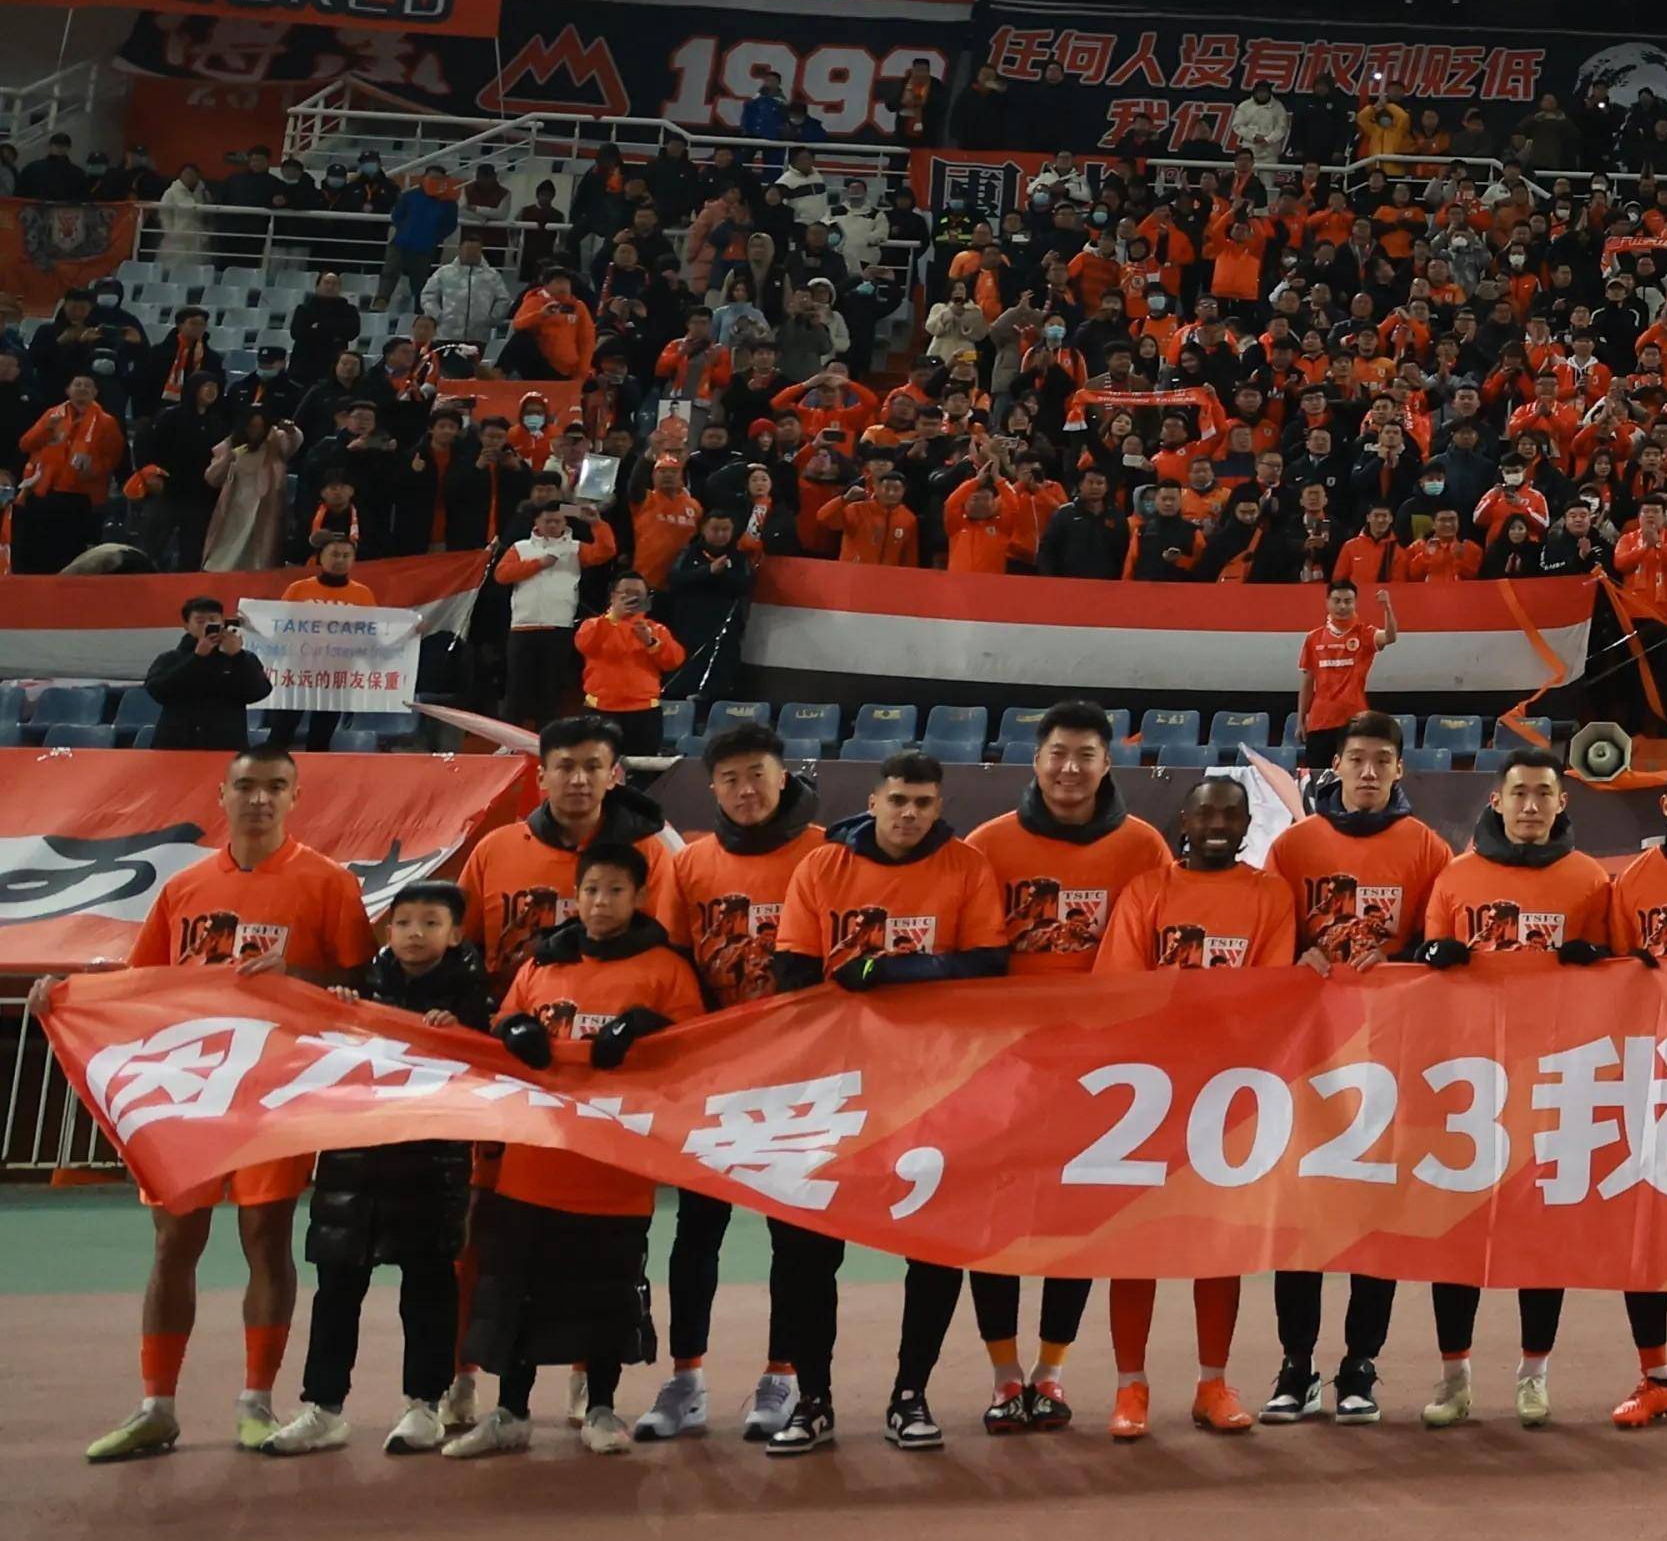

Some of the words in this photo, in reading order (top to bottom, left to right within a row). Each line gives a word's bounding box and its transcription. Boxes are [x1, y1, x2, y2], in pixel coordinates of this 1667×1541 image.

[986, 24, 1547, 102] 任何人没有权利贬低
[272, 618, 322, 635] TAKE
[326, 619, 378, 637] CARE
[262, 667, 408, 692] 们永远的朋友保重!
[1063, 890, 1105, 901] TSFC
[1359, 887, 1400, 897] TSFC
[752, 905, 783, 915] TSF
[889, 917, 934, 927] TSFC
[1523, 914, 1562, 923] TSFC
[242, 925, 283, 936] TSFC
[1208, 937, 1248, 948] TSFC
[580, 1015, 614, 1024] TSF
